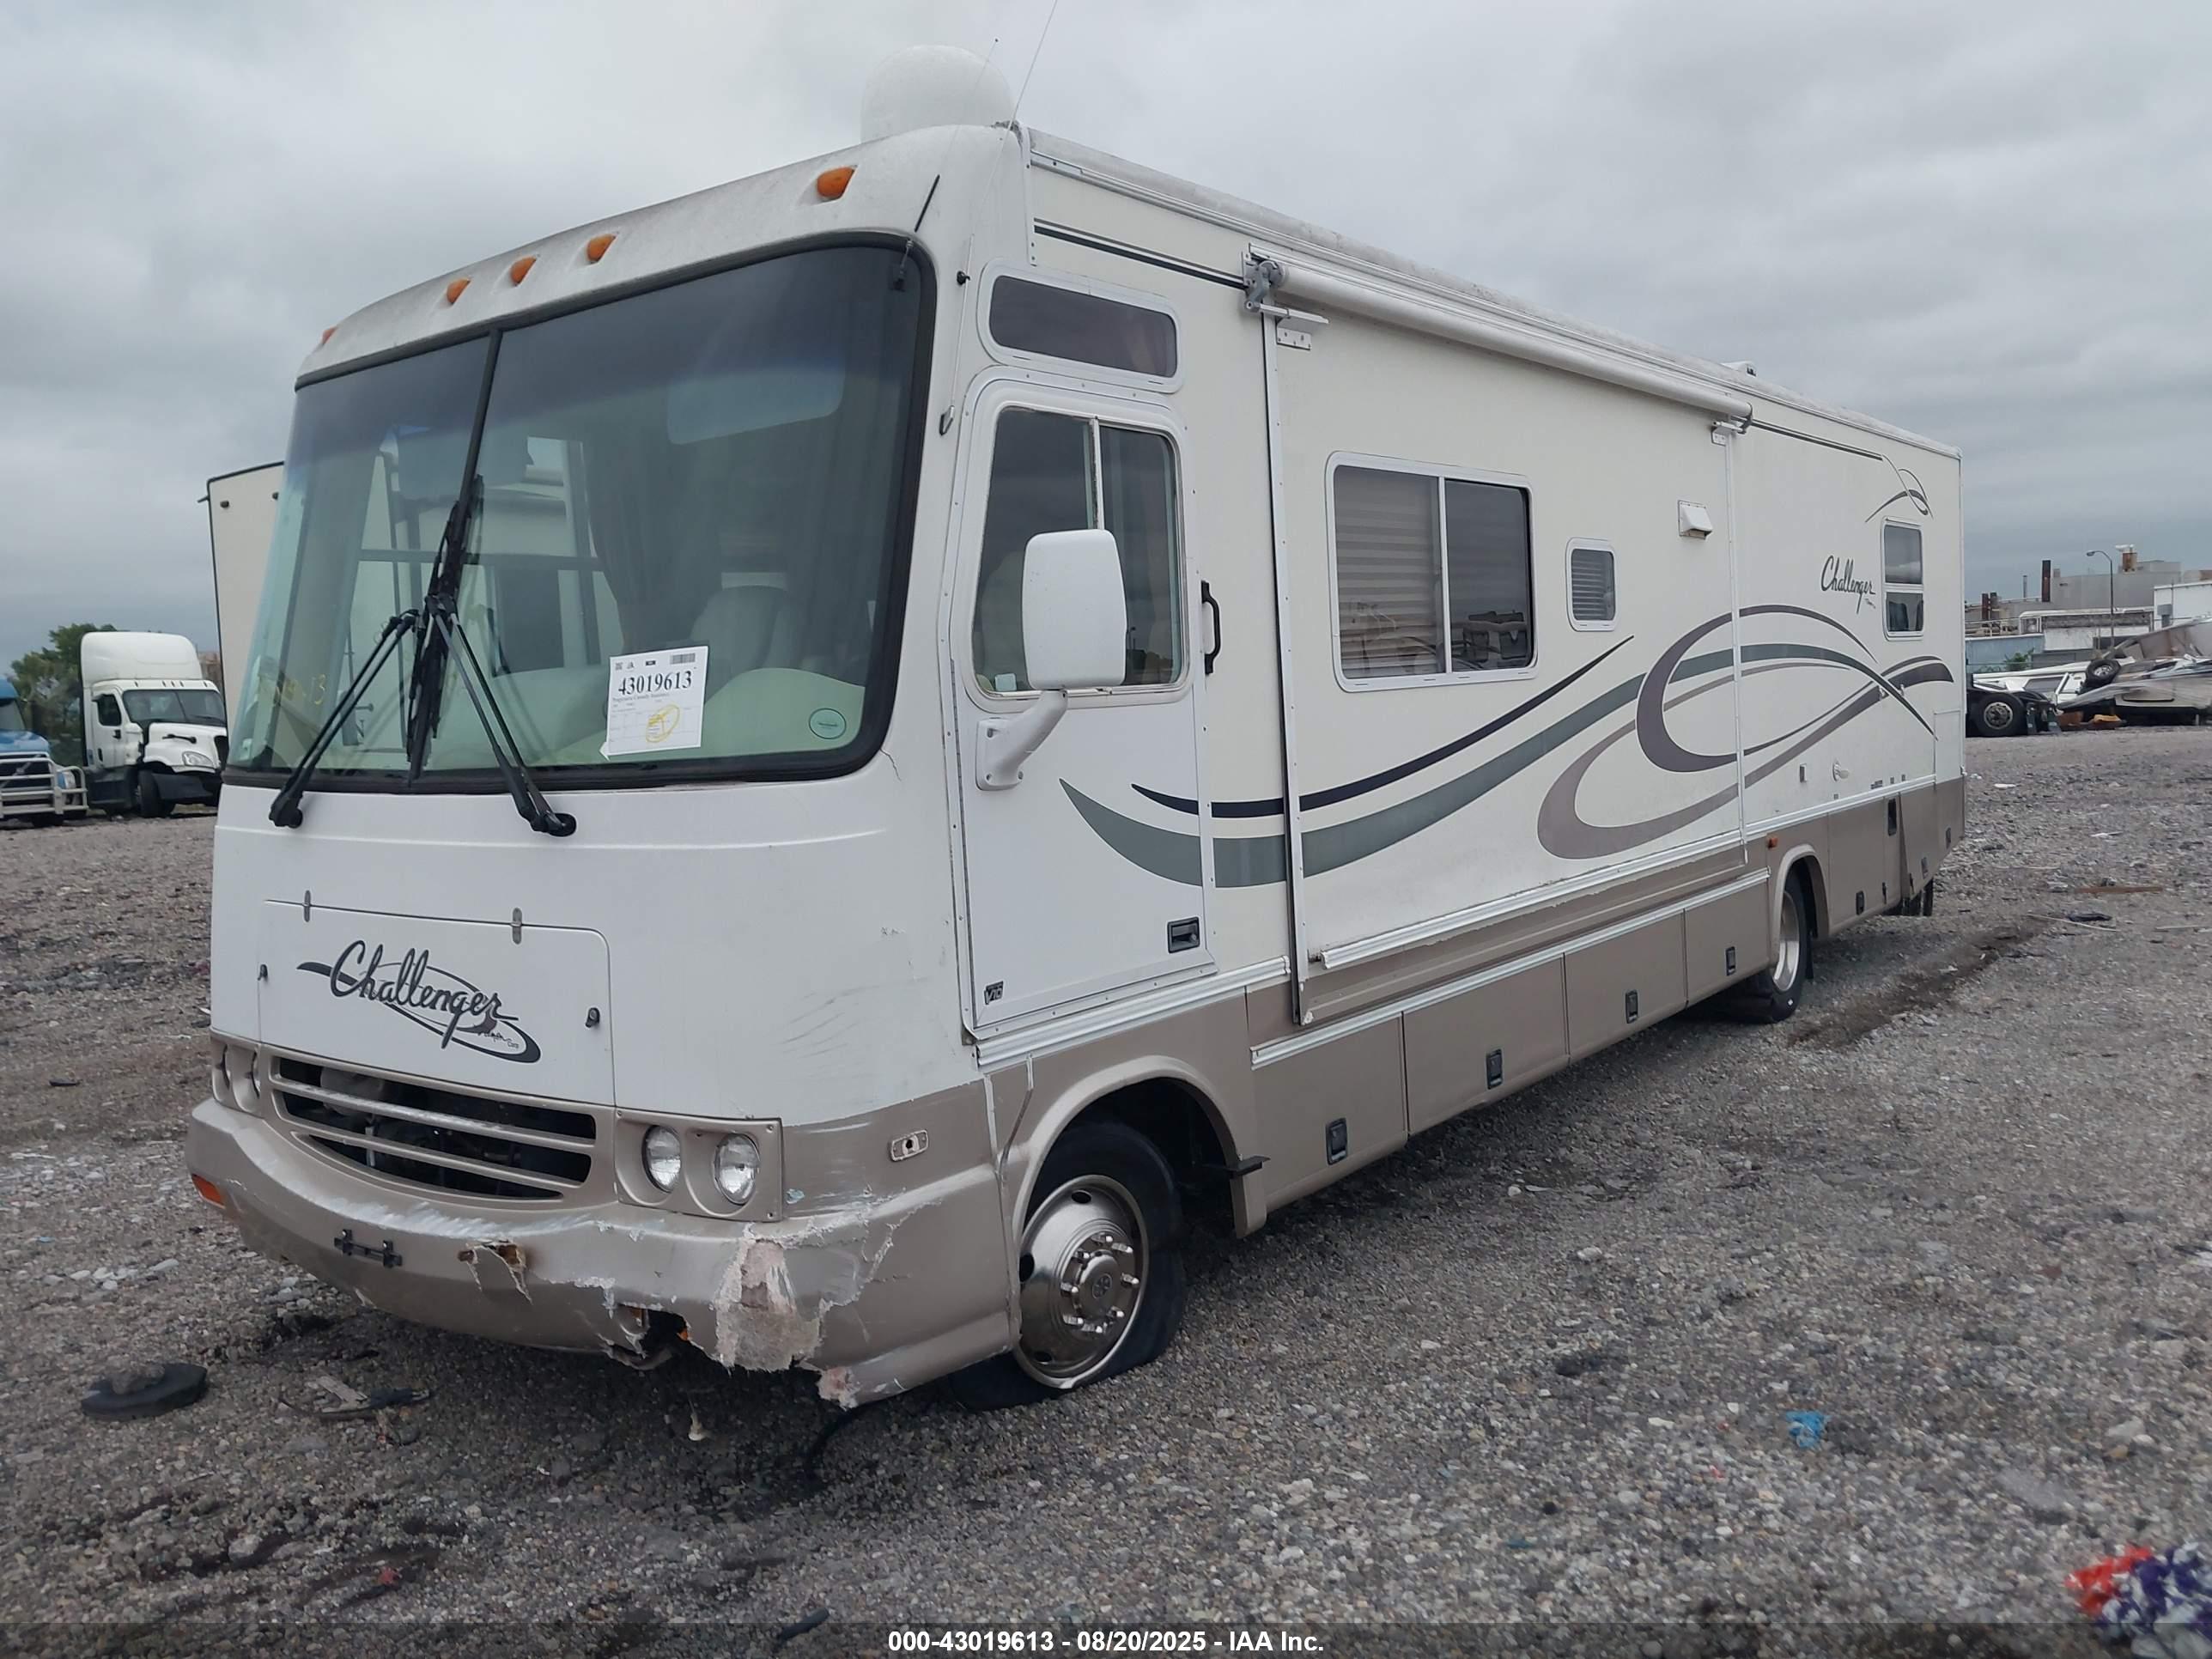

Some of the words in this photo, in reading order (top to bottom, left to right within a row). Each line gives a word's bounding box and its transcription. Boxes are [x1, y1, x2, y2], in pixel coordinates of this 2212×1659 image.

[1820, 555, 1876, 614] Challenger
[617, 670, 692, 696] 43019613
[330, 939, 520, 1049] Challenger
